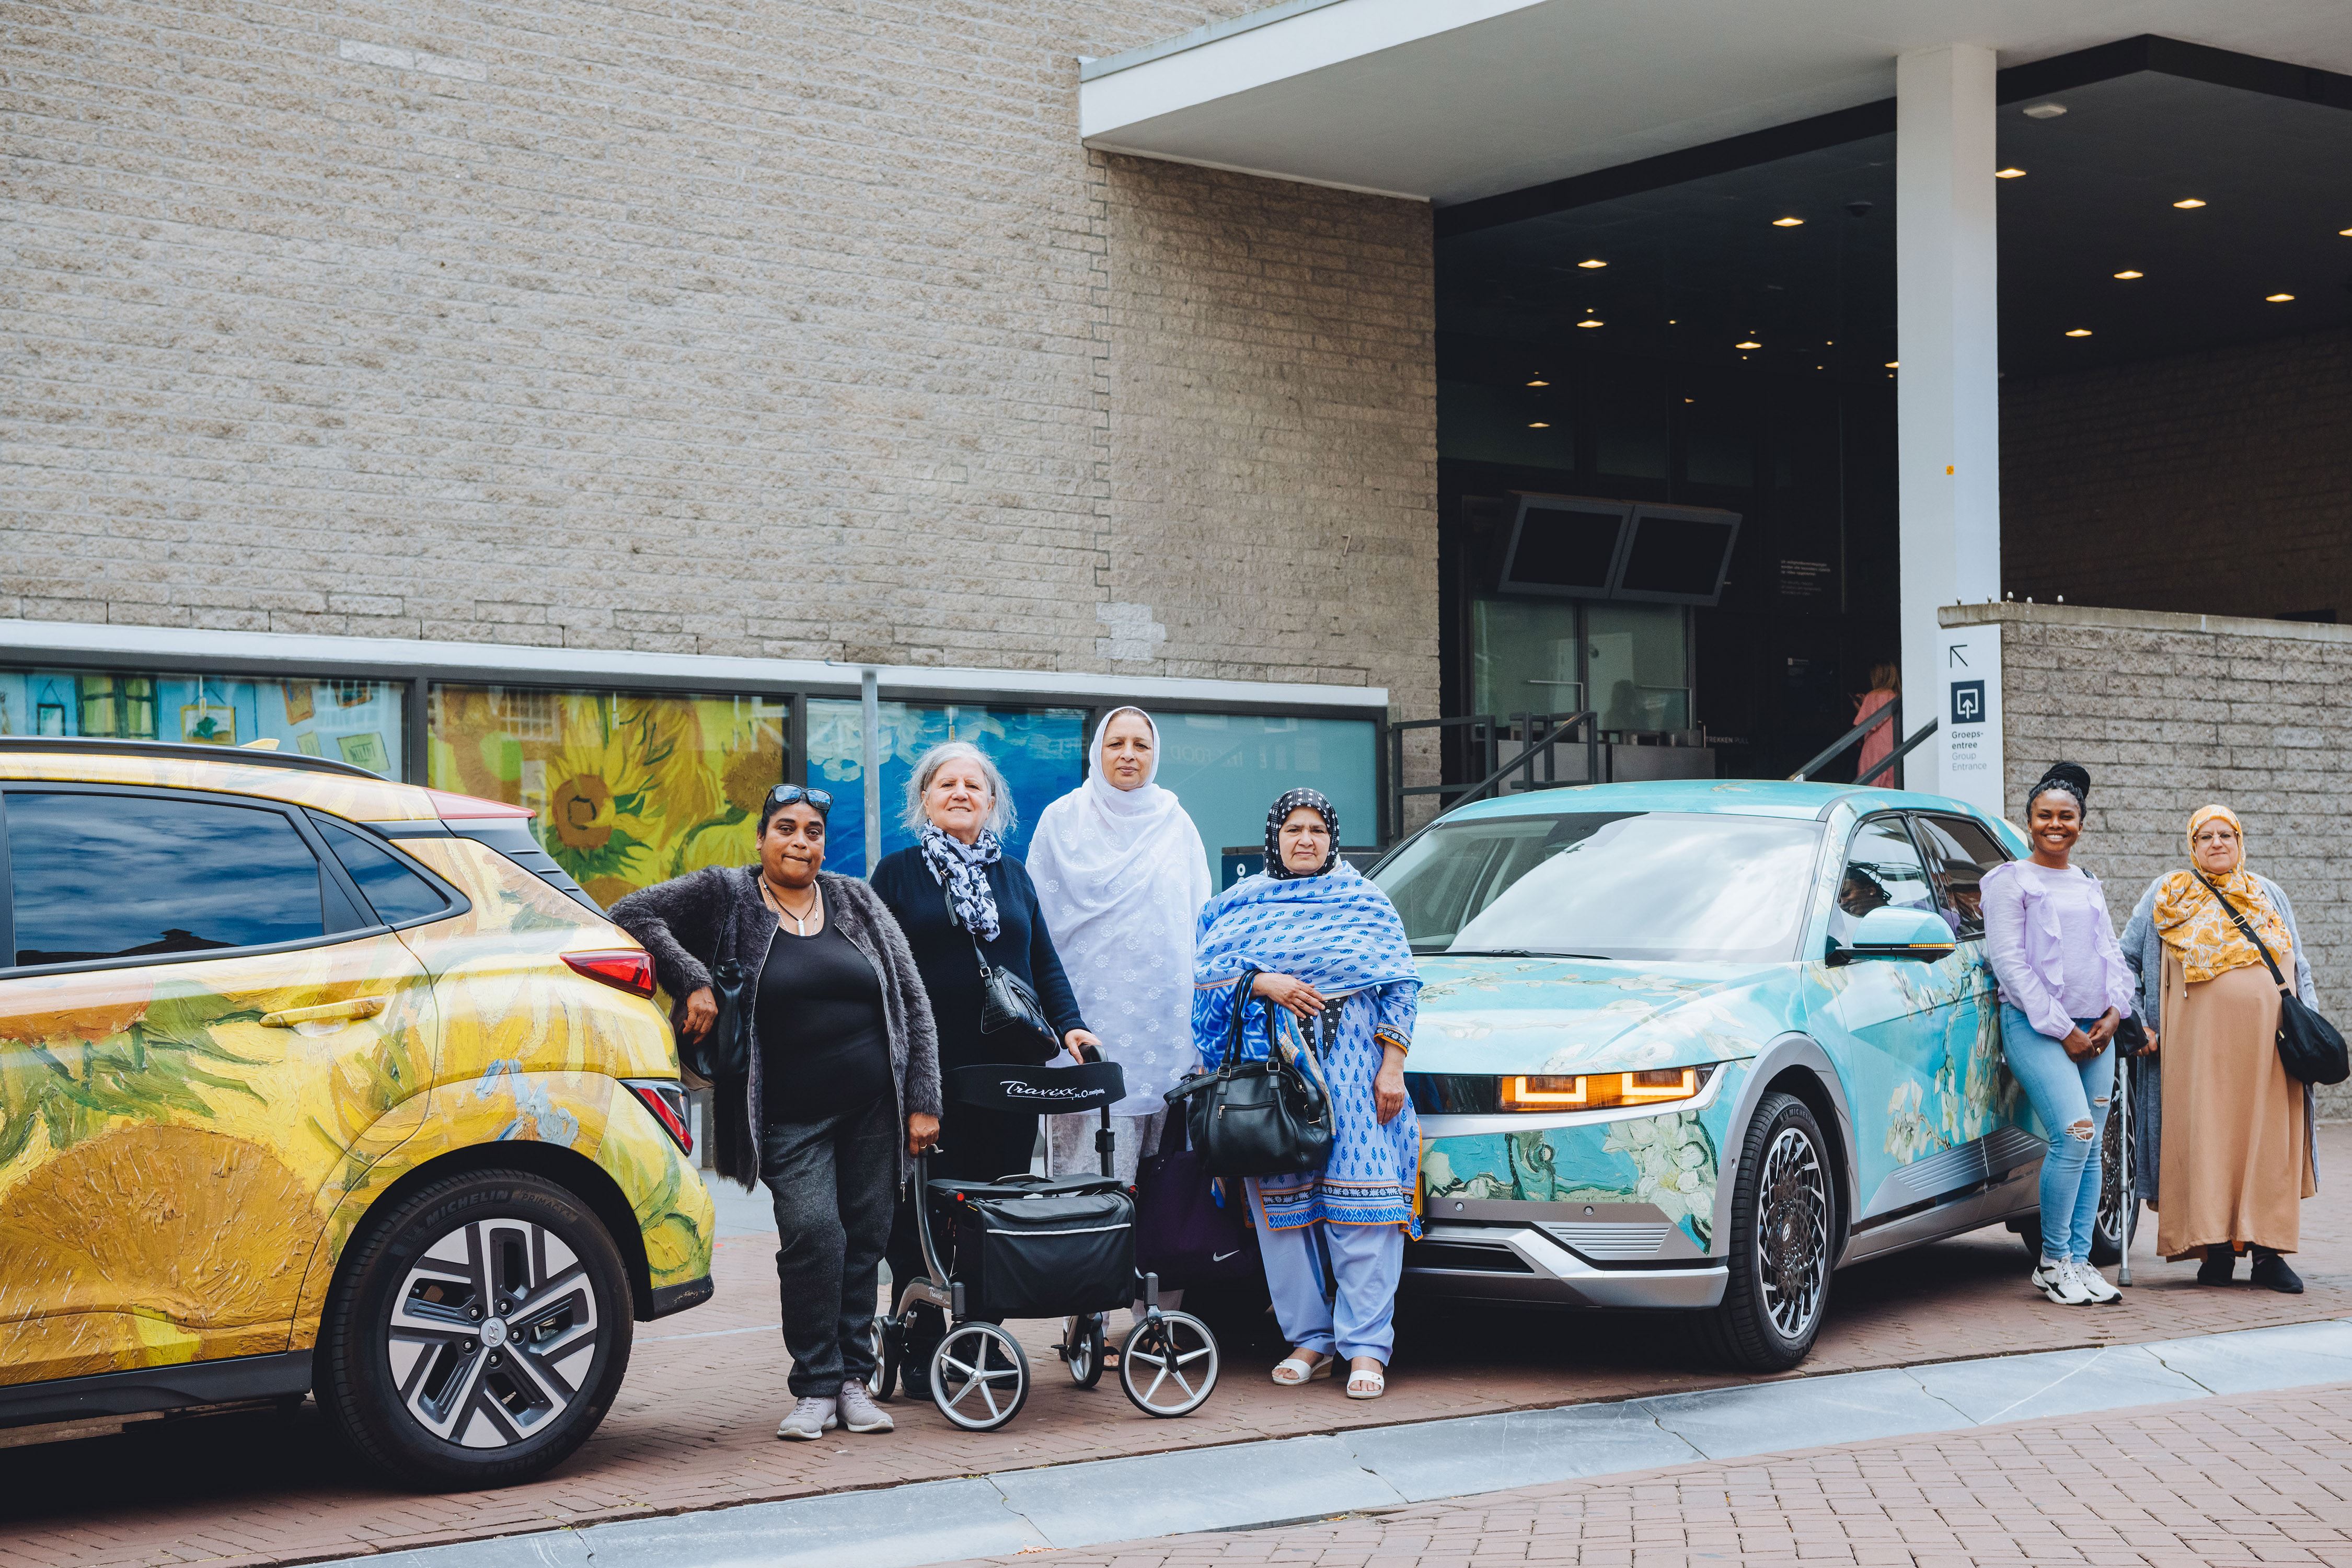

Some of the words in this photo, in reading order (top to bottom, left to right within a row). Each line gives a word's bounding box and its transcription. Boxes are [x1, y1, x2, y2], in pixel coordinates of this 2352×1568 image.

[1952, 731, 1984, 739] Groeps-
[1952, 763, 1987, 771] Entrance
[1000, 1080, 1077, 1098] Travixx
[1789, 1108, 1814, 1125] MICHELIN
[425, 1190, 509, 1226] MICHELIN
[521, 1193, 567, 1215] PRIMACY
